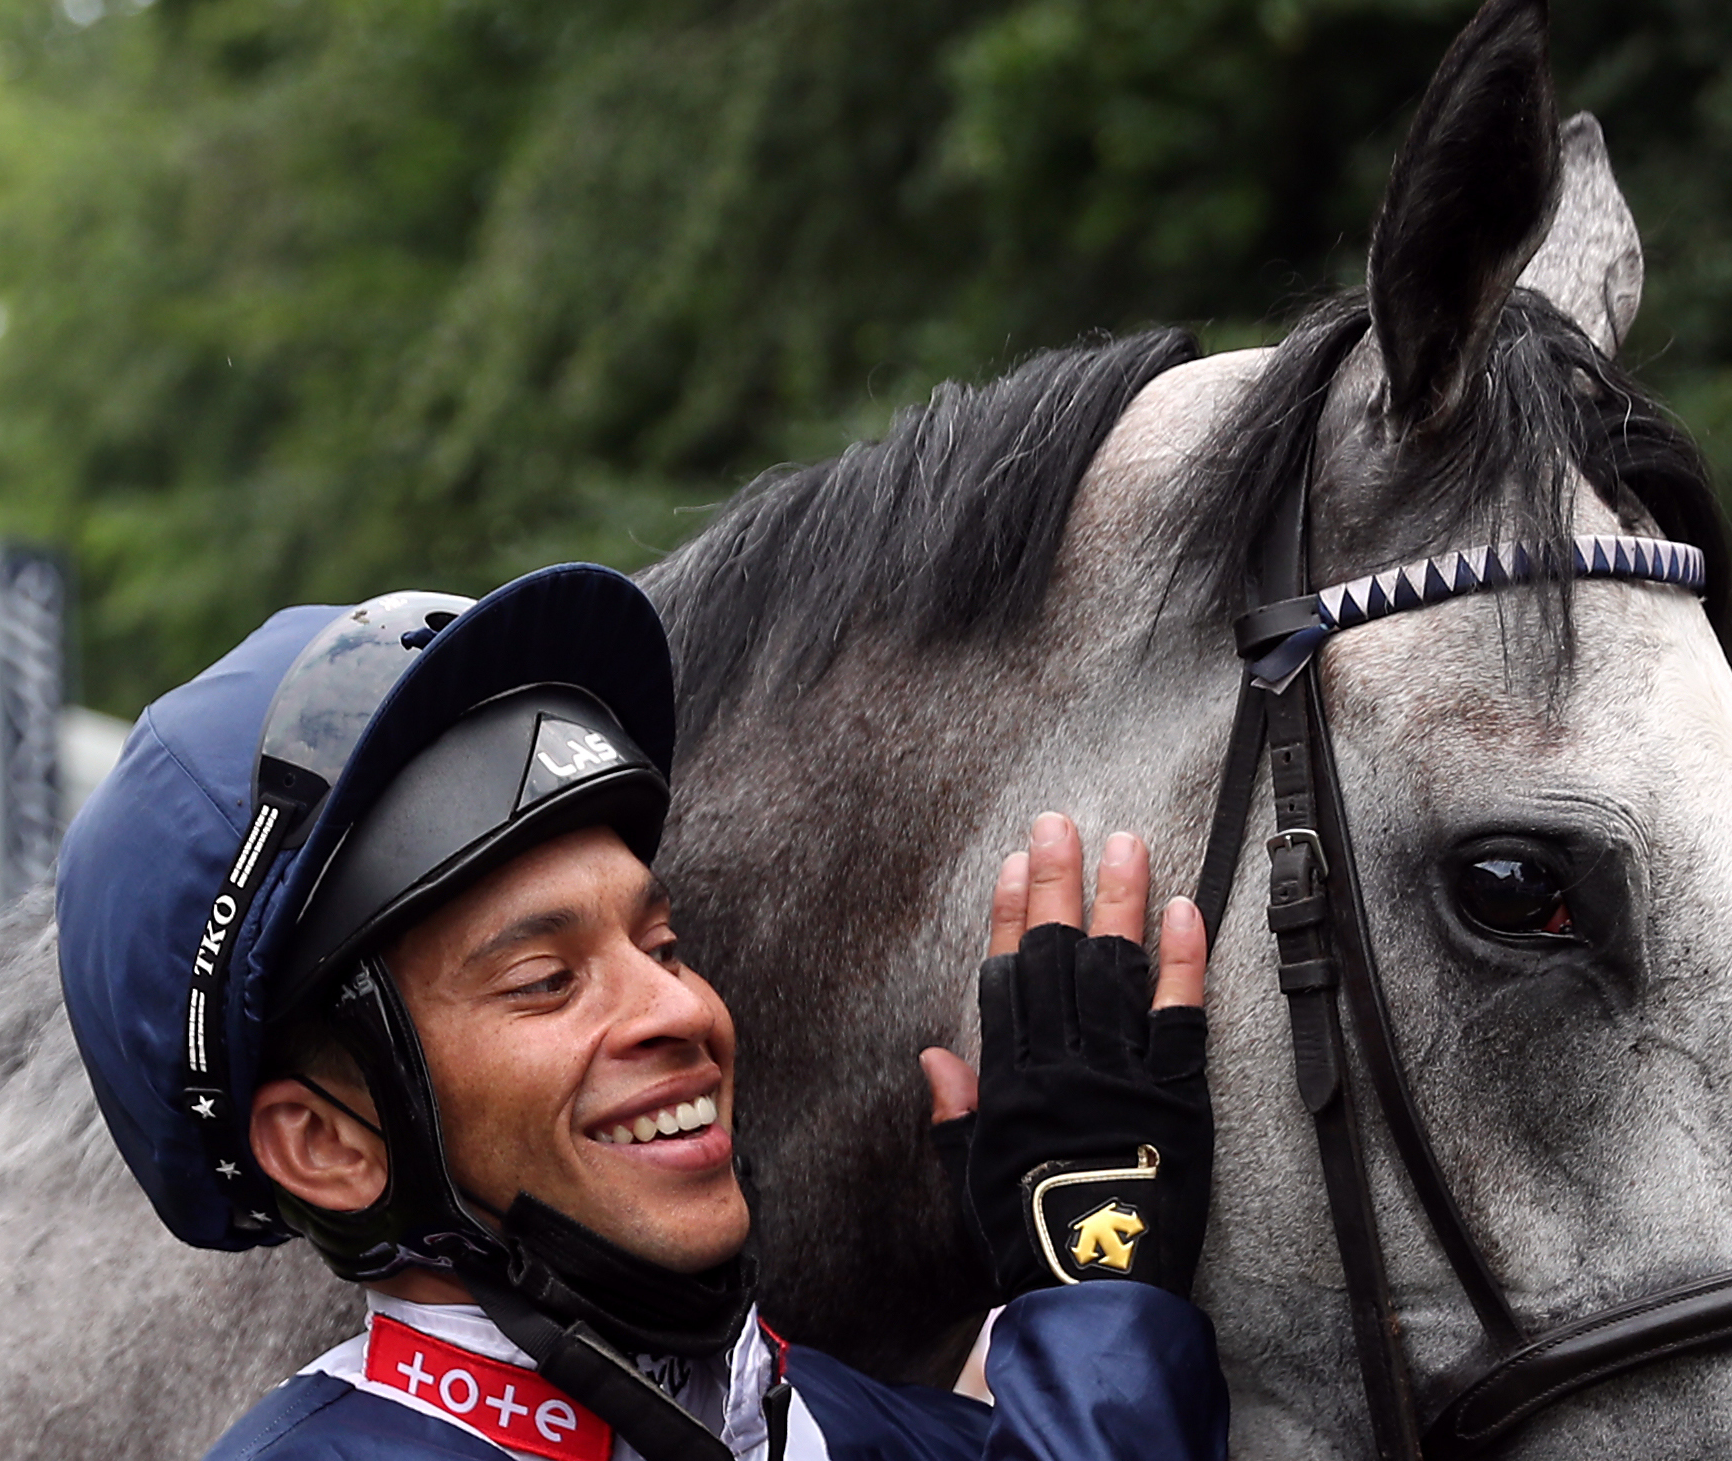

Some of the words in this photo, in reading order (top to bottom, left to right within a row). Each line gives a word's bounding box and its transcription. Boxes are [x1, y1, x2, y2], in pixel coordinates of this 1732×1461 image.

[537, 733, 617, 777] LAS
[193, 894, 237, 977] TKO
[396, 1351, 577, 1443] tote
